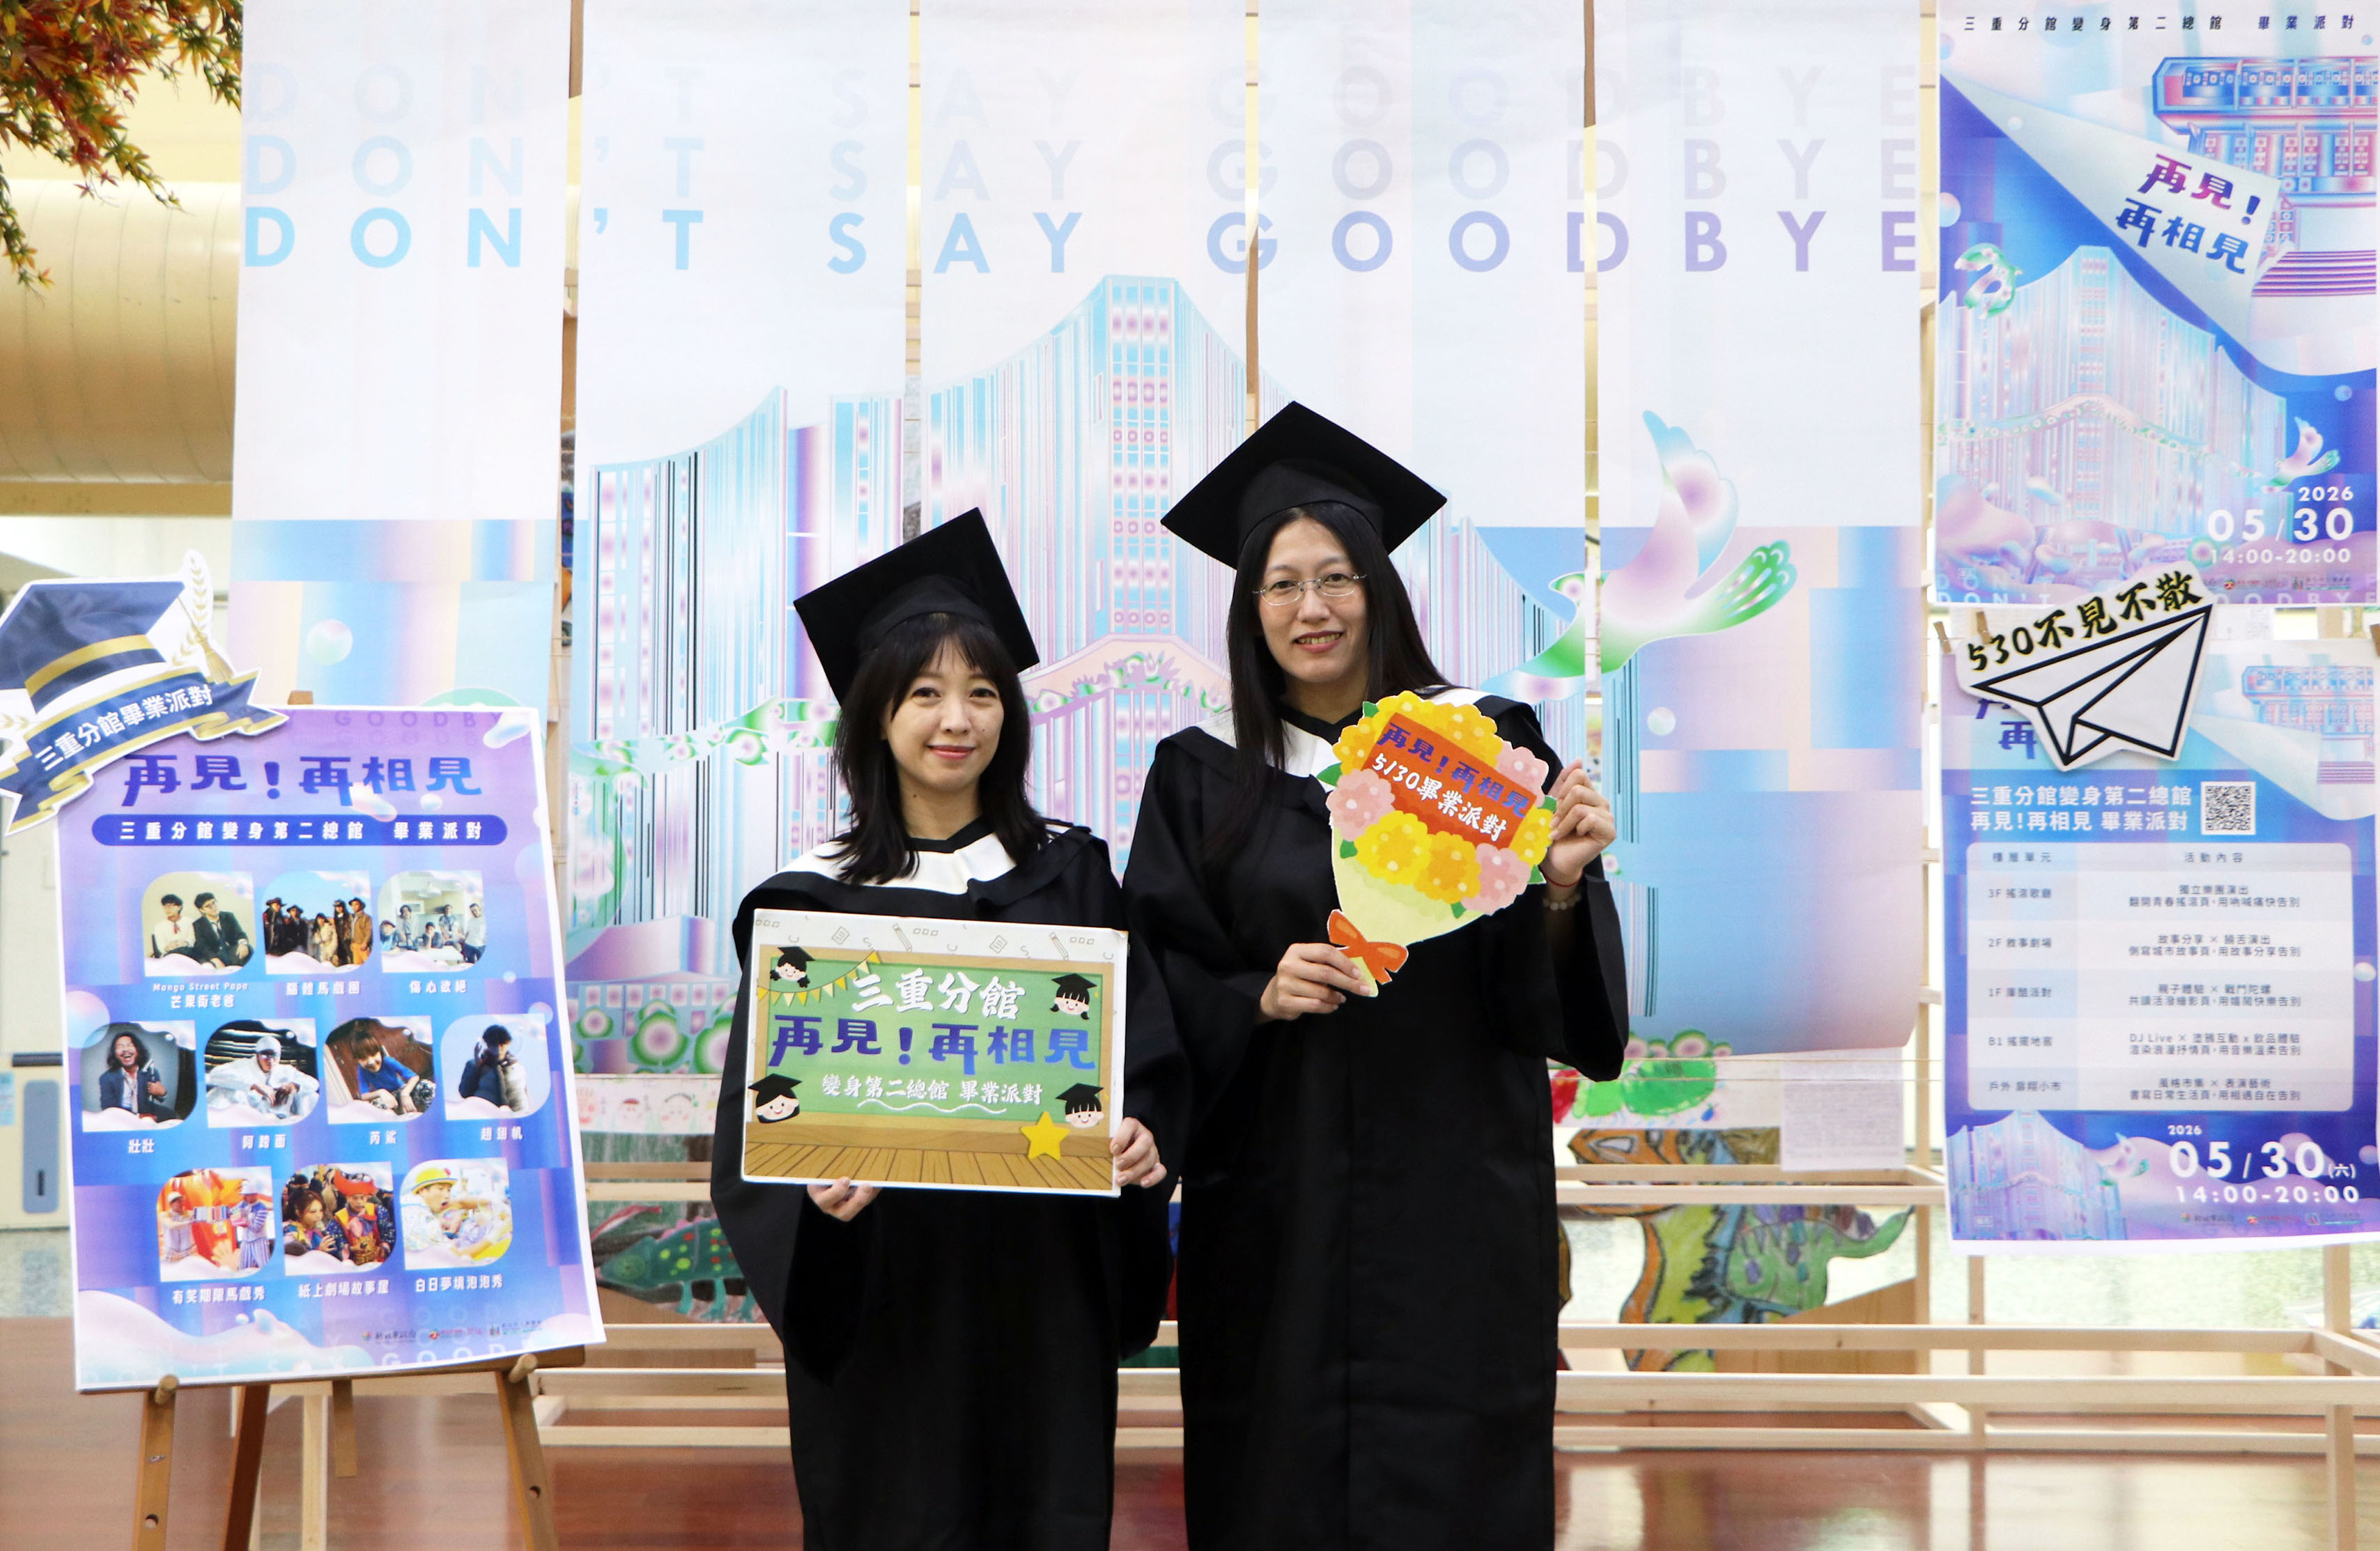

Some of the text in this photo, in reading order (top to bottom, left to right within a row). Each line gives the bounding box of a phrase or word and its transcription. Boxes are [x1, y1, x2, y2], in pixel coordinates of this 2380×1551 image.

[1965, 15, 2354, 31] 三重分館變身第二總館 畢業派對
[828, 139, 1082, 202] SAY
[1207, 138, 1916, 202] GOODBYE
[245, 207, 1916, 274] DON'T SAY GOODBYE
[2115, 197, 2250, 275] 再相見
[2298, 486, 2354, 502] 2026
[2211, 548, 2351, 564] 14:00-20:00
[1968, 570, 2203, 671] 530不見不散
[35, 682, 213, 771] 三重分館畢業派對
[1372, 752, 1508, 842] 5/30畢業派對
[1970, 786, 2193, 807] 三重分館變身第二總館
[2101, 810, 2188, 831] 畢業派對
[121, 821, 482, 841] 三重分館變身第二總館 畢業派對
[1988, 888, 2002, 897] 3F
[1988, 937, 2002, 947] 2F
[2158, 934, 2204, 945] 故事分享
[189, 981, 220, 992] Street
[224, 980, 248, 992] Papa
[410, 980, 468, 994] 傷心欲絕
[851, 967, 1026, 1021] 三重分館
[1988, 987, 2002, 996] 1F
[171, 994, 235, 1009] 芒果街老爸
[1988, 1035, 2003, 1046] B1
[2128, 1033, 2144, 1042] DJ
[2148, 1033, 2173, 1042] Live
[822, 1074, 1043, 1106] 變身第二總館 畢業派對
[2168, 1124, 2202, 1136] 2026
[2175, 1185, 2360, 1203] 14:00-20:00
[415, 1274, 503, 1293] 白日夢境泡泡秀
